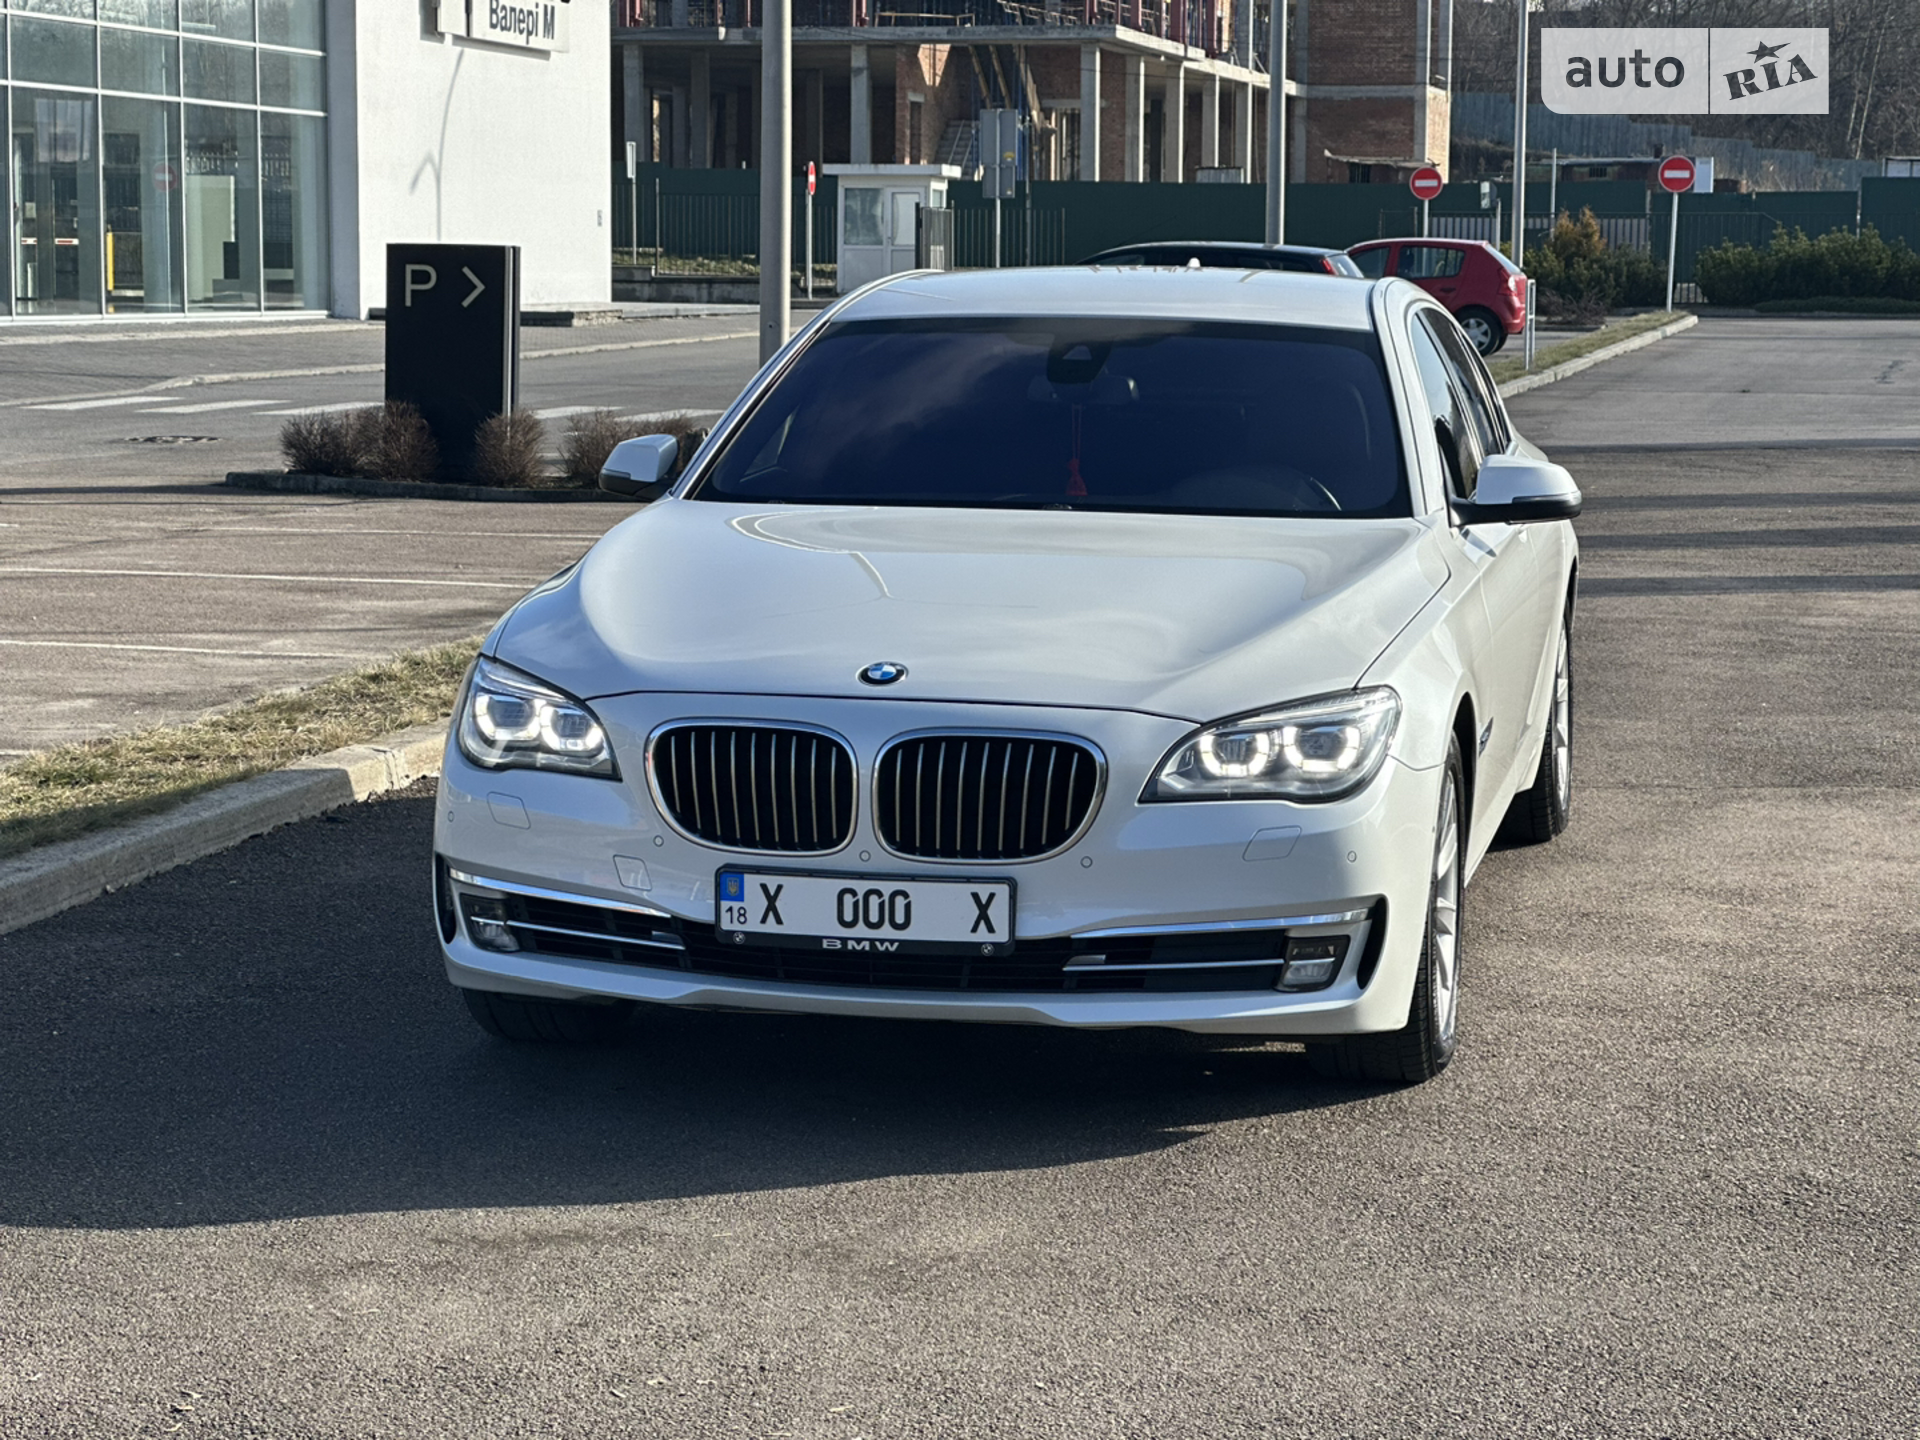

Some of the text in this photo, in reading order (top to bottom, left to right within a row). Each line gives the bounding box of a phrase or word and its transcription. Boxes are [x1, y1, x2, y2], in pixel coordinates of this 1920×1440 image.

[488, 0, 540, 45] Валері
[404, 263, 438, 308] P
[725, 905, 748, 925] 18
[822, 938, 900, 951] BMW
